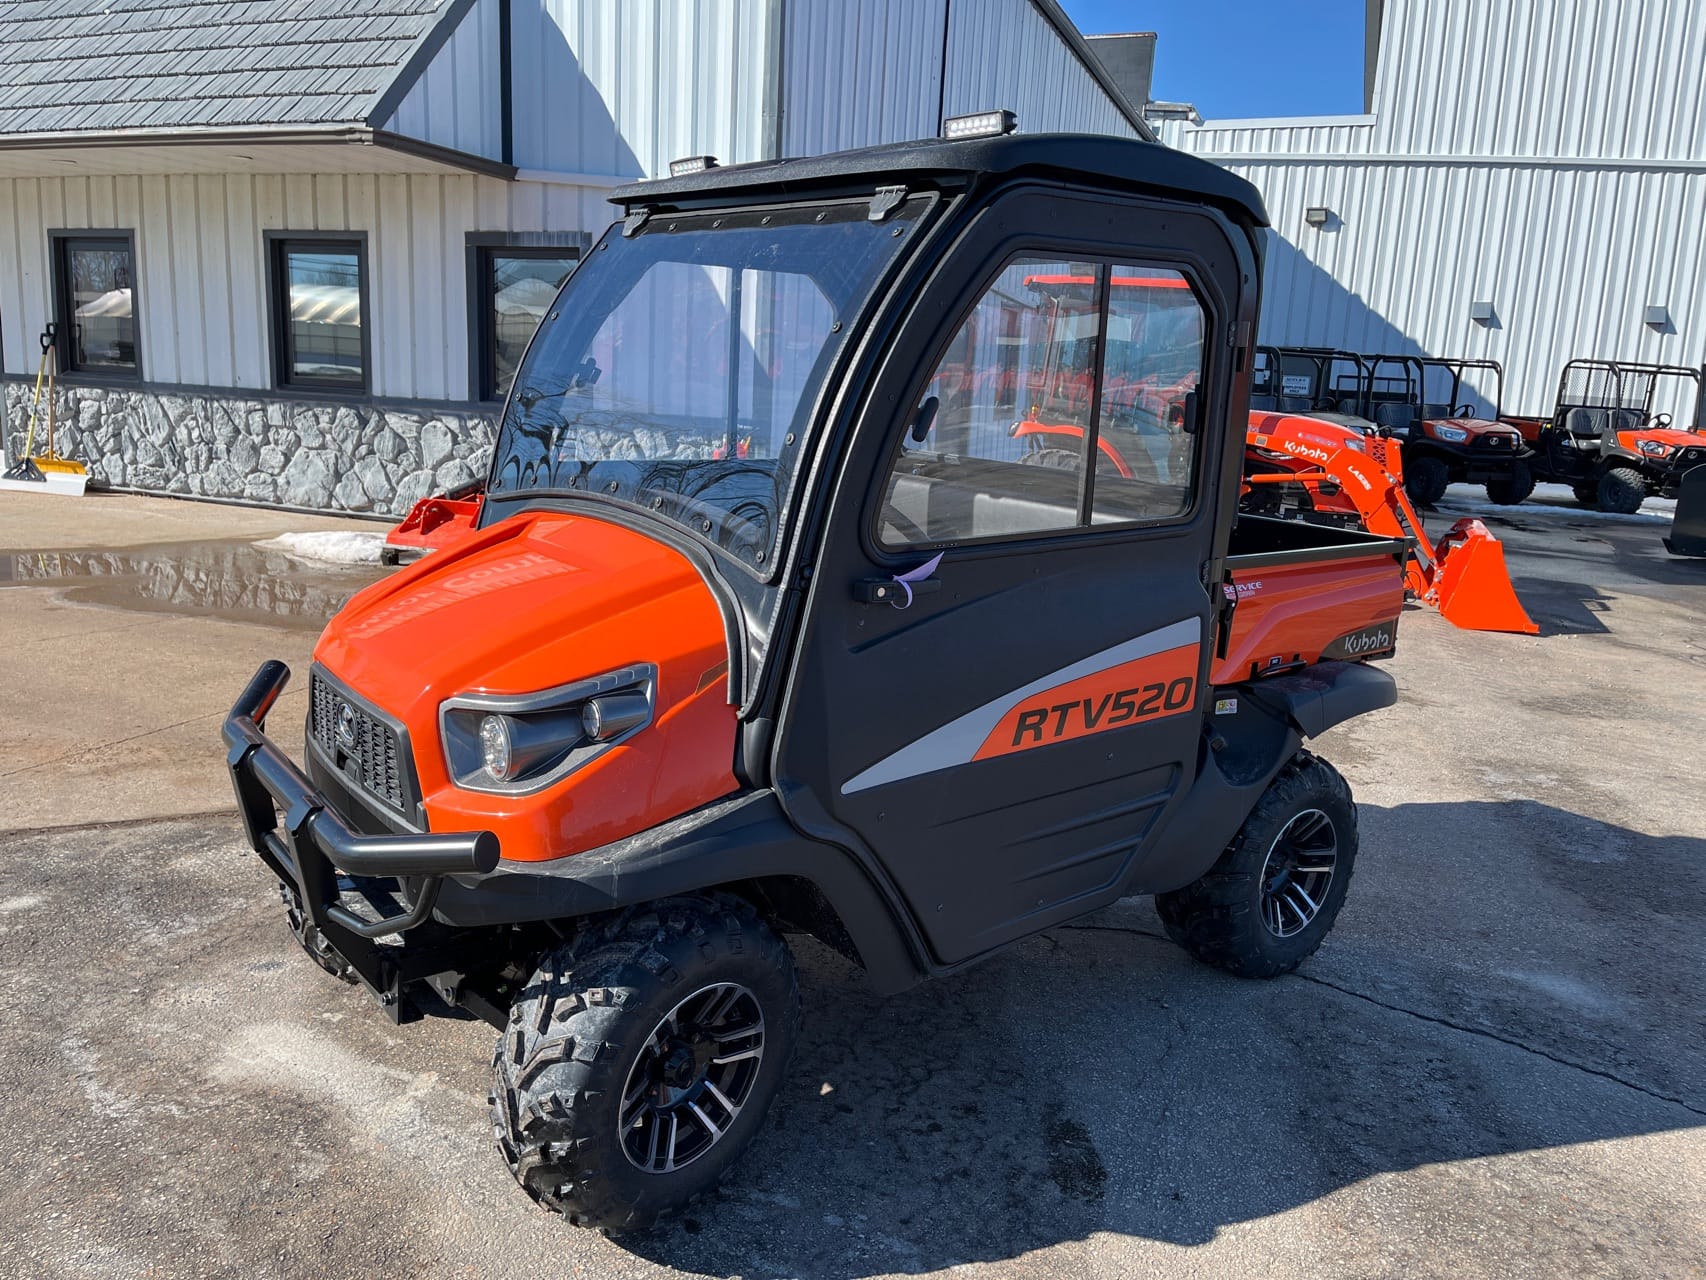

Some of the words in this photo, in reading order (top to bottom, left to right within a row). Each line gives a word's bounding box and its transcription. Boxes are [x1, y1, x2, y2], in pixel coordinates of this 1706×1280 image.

[1284, 440, 1328, 461] Kubota
[1223, 581, 1263, 594] SERVICE
[1344, 629, 1389, 653] Kubota
[1012, 676, 1194, 746] RTV520
